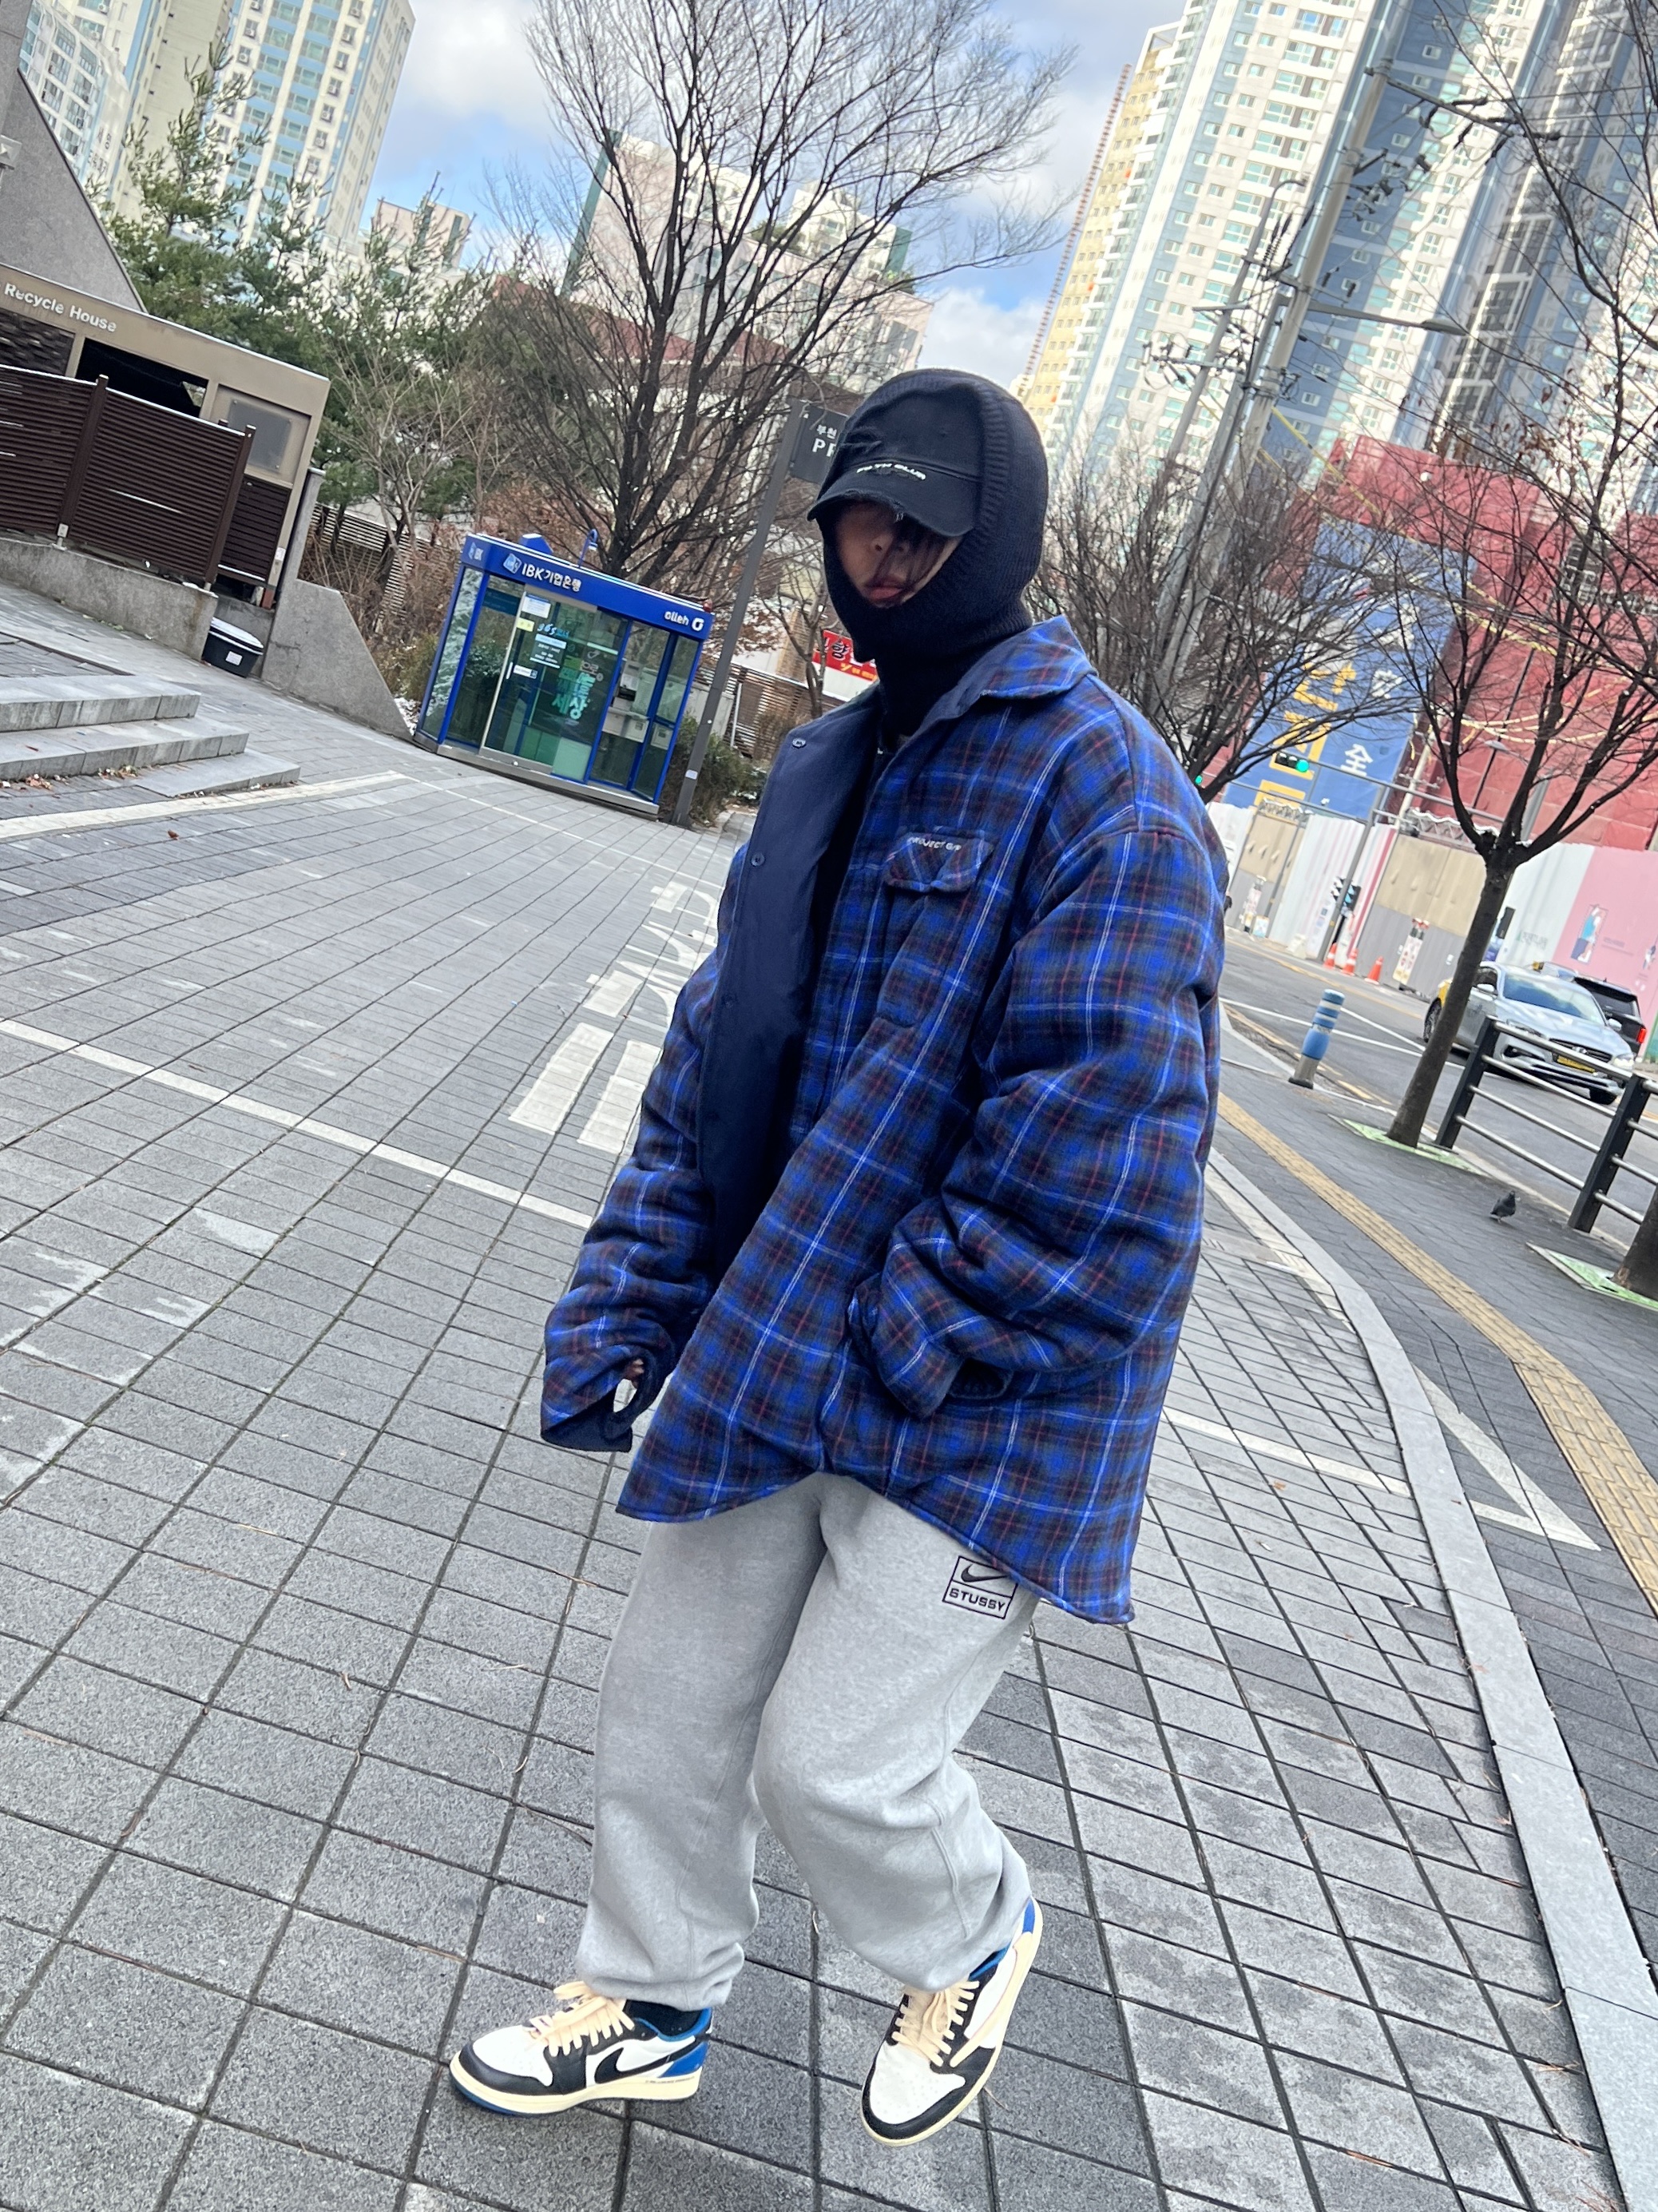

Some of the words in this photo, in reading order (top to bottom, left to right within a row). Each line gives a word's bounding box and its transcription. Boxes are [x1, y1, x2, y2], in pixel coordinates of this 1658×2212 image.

[4, 283, 64, 314] Recycle
[69, 304, 117, 332] House
[522, 562, 582, 592] IBK기업은행
[949, 1587, 1006, 1611] STUSSY
